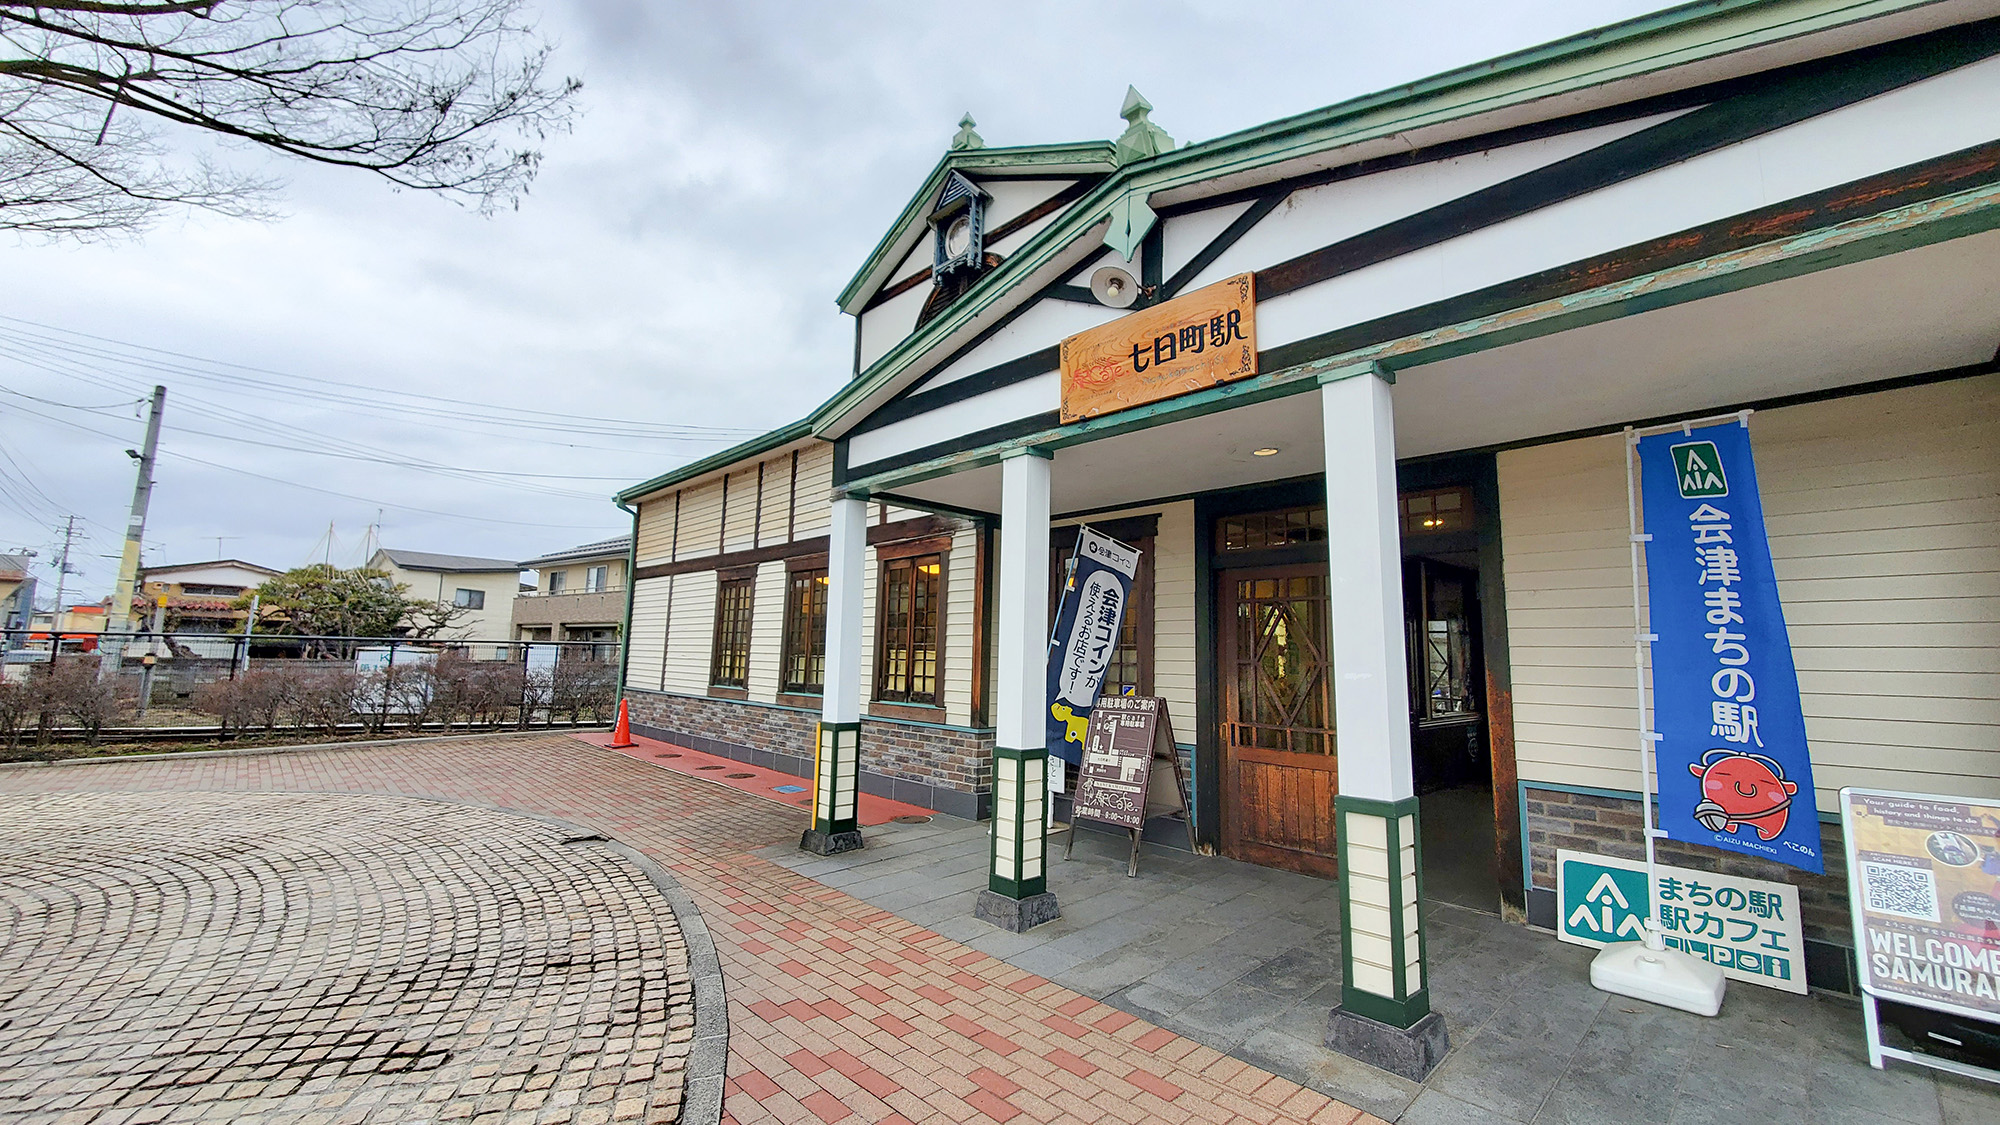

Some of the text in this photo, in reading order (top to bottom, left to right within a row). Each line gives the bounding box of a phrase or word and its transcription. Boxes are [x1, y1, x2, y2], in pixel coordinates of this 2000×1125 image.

[1128, 308, 1248, 373] 七日町駅
[1098, 546, 1131, 569] 会津コイン
[1068, 581, 1102, 694] 使えるお店です！
[1085, 588, 1120, 688] 会津コインが
[1688, 503, 1764, 748] 会津まちの駅
[1863, 798, 1960, 814] Your guide to food,
[1874, 808, 1978, 825] history and things to do
[1783, 840, 1815, 857] べこのん
[1658, 877, 1784, 921] まちの駅
[1660, 904, 1790, 952] 駅カフェ
[1868, 928, 2000, 975] WELCOME
